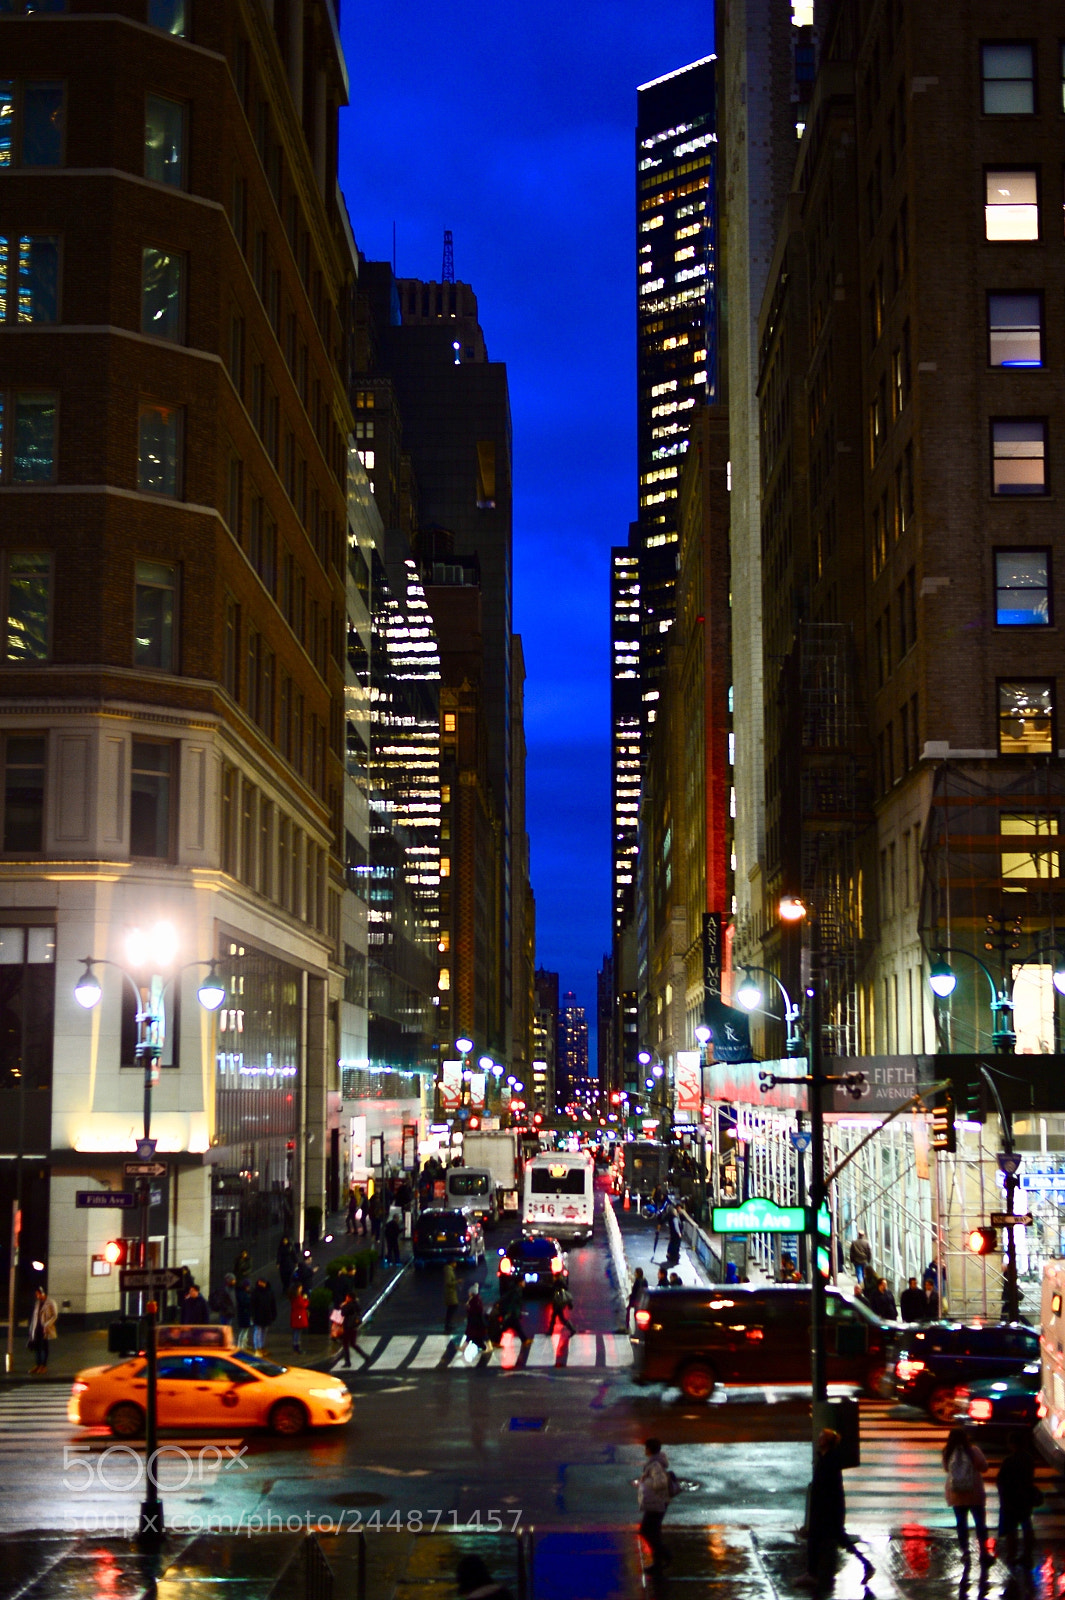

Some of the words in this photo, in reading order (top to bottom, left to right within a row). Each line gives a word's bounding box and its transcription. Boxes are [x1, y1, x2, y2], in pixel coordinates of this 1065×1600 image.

[707, 917, 718, 964] ANNIE
[874, 1067, 916, 1084] FIFTH
[875, 1087, 916, 1099] AVENUE
[86, 1195, 107, 1204] Fifth
[109, 1195, 125, 1204] Ave
[726, 1212, 760, 1228] Fifth
[762, 1212, 791, 1228] Ave
